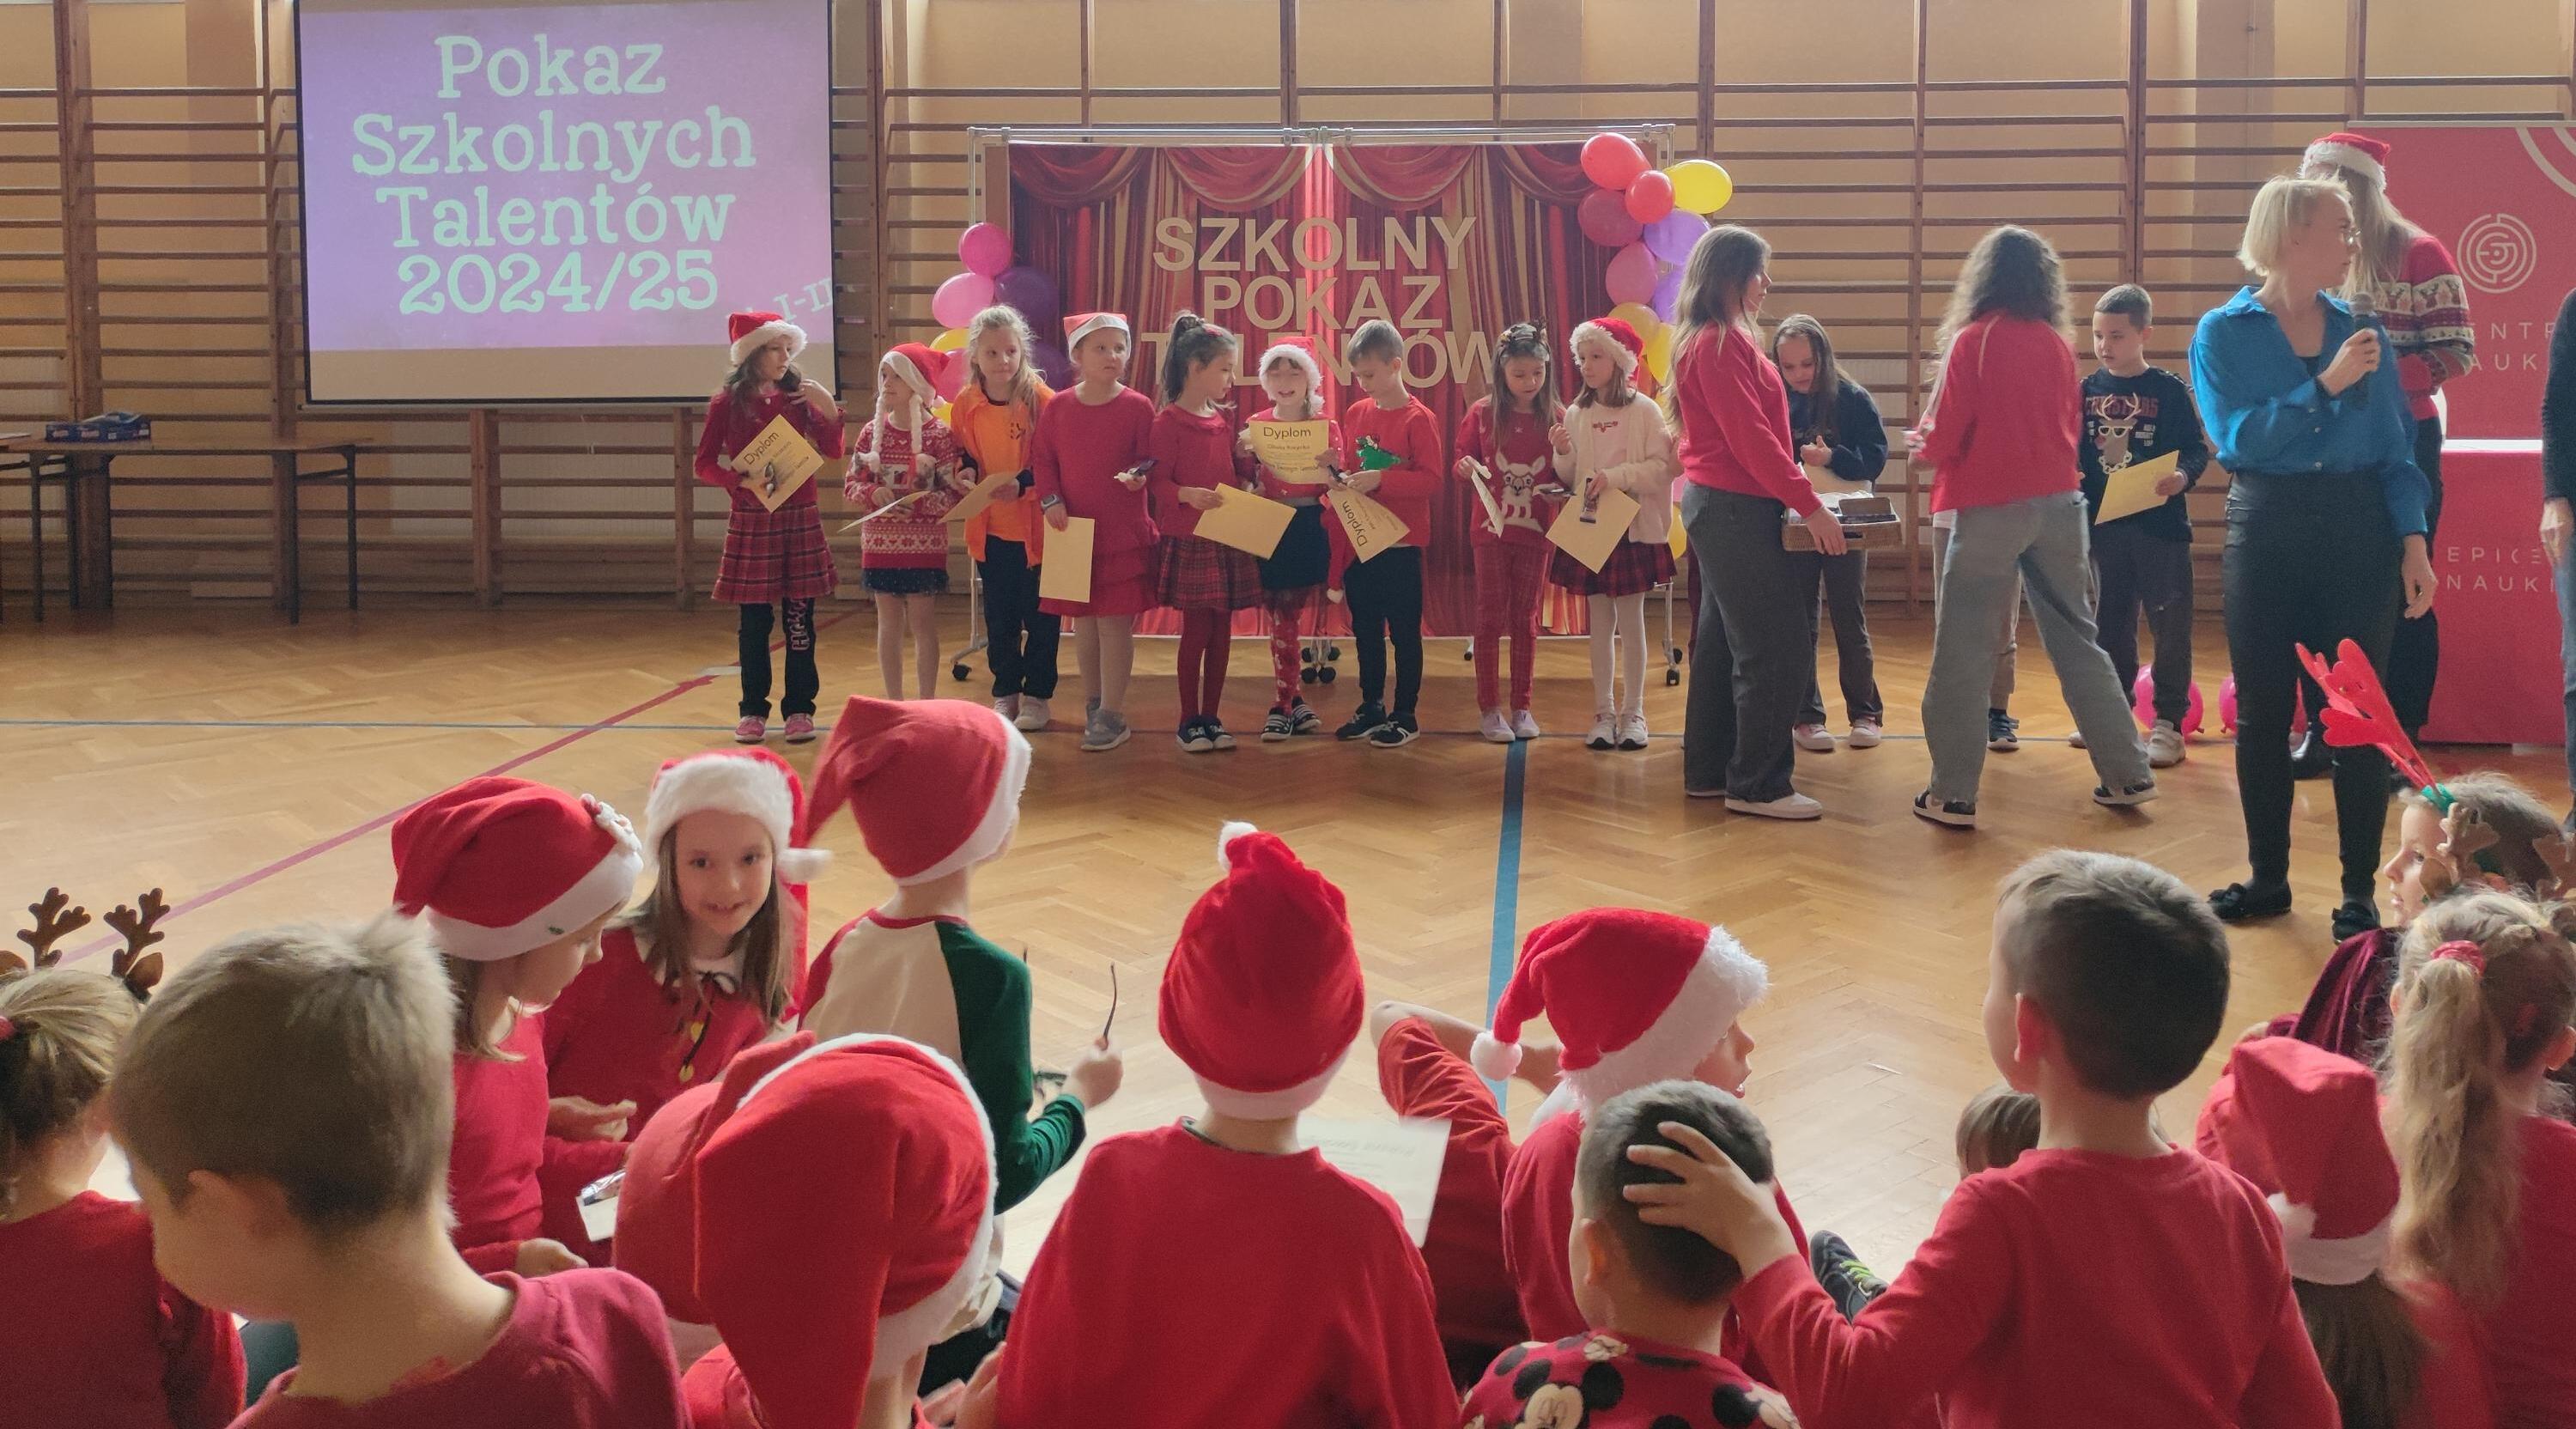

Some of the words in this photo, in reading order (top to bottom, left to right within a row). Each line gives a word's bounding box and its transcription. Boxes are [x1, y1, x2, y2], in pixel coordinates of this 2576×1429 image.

[434, 33, 667, 99] Pokaz
[352, 105, 756, 184] Szkolnych
[375, 181, 737, 249] Talentów
[1152, 216, 1478, 272] SZKOLNY
[398, 249, 720, 316] 2024/25
[1204, 275, 1443, 331] POKAZ
[744, 432, 780, 465] Dyplom
[1263, 427, 1311, 440] Dyplom
[1342, 501, 1368, 547] Dyplom
[2447, 575, 2555, 593] NAUKI
